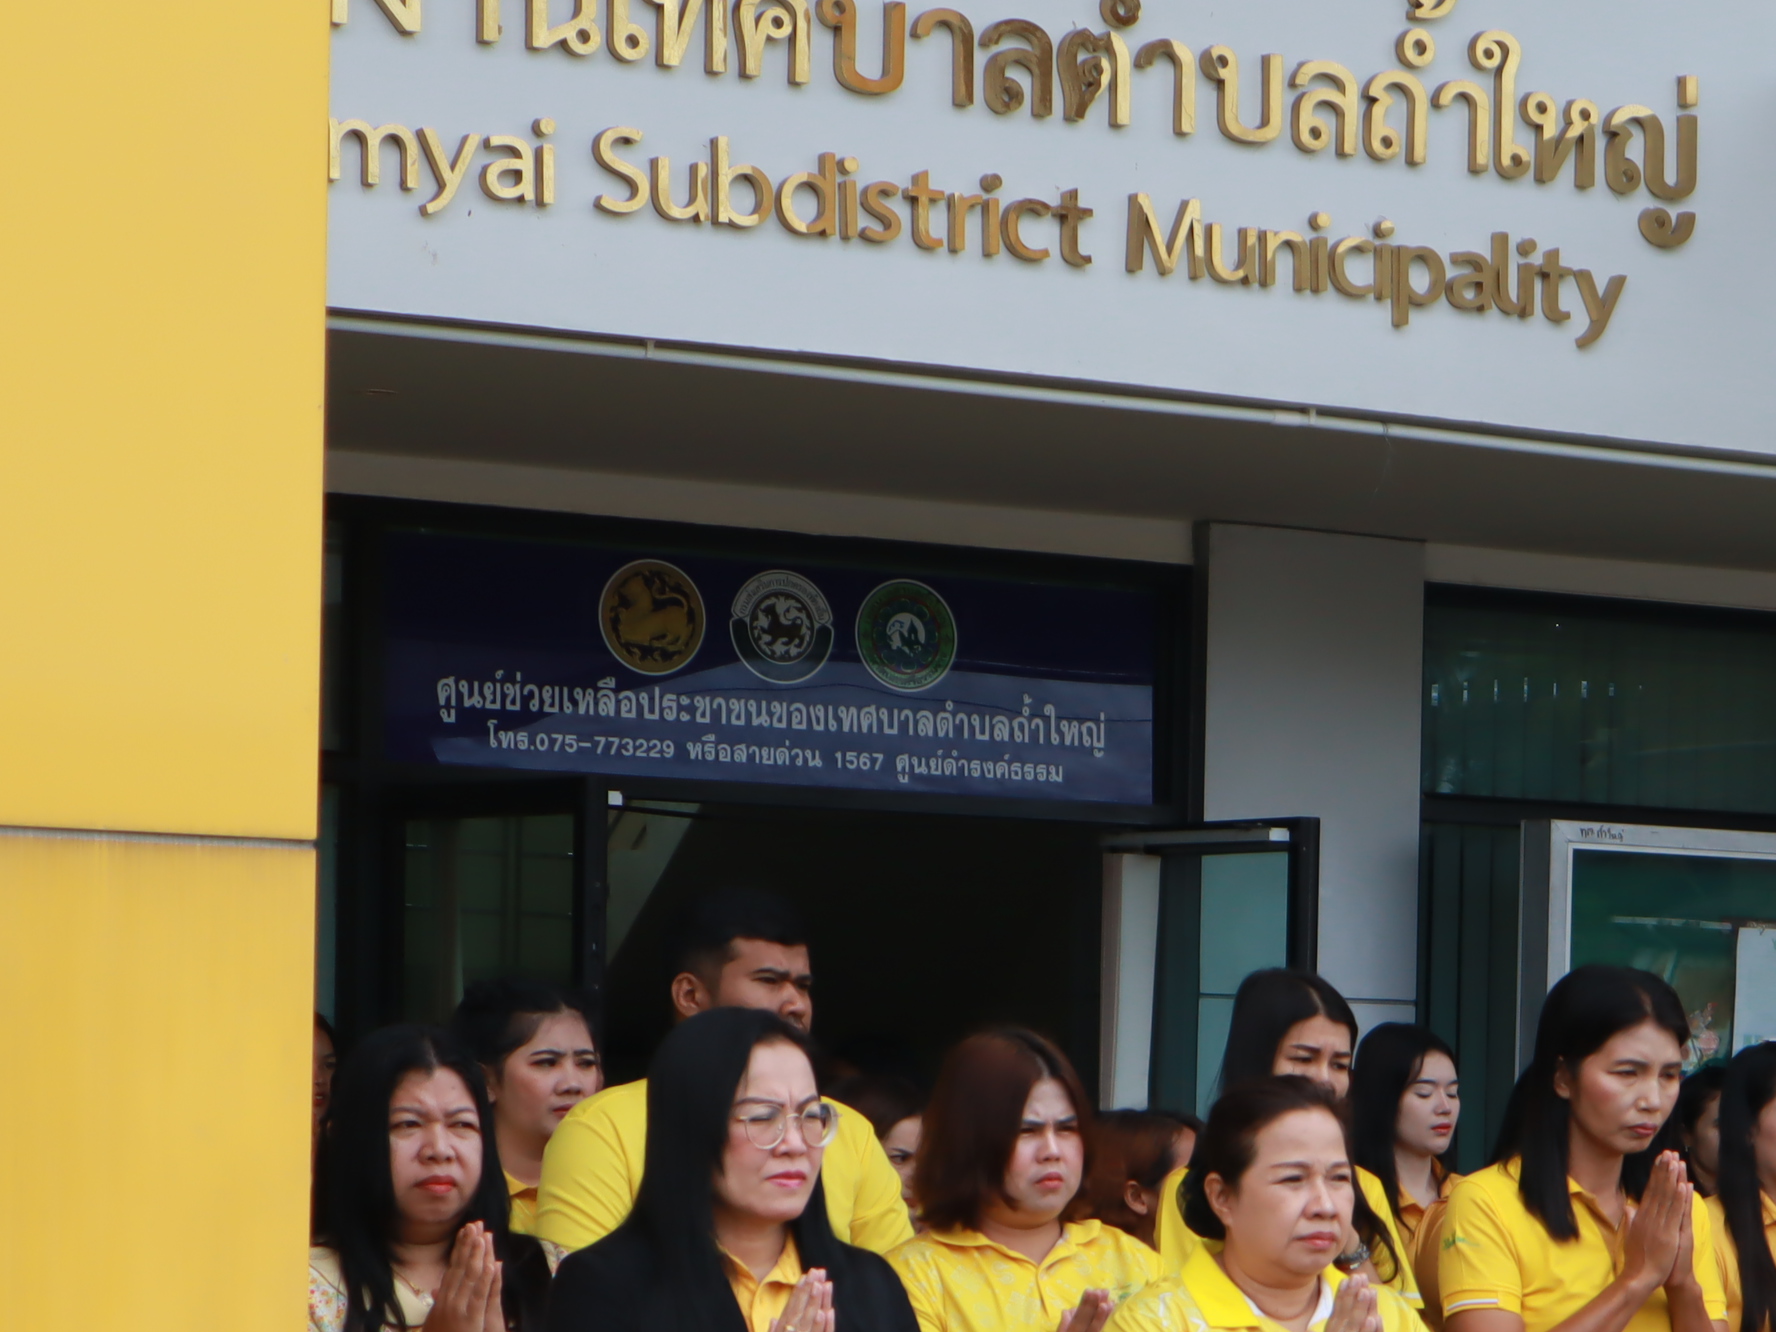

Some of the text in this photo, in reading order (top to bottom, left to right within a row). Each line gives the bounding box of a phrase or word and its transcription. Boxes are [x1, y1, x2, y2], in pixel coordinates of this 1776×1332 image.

[328, 117, 1628, 349] myai Subdistrict Municipality
[487, 720, 675, 758] โทร.075-773229
[686, 733, 822, 767] หรือสายด่วน
[834, 751, 884, 771] 1567
